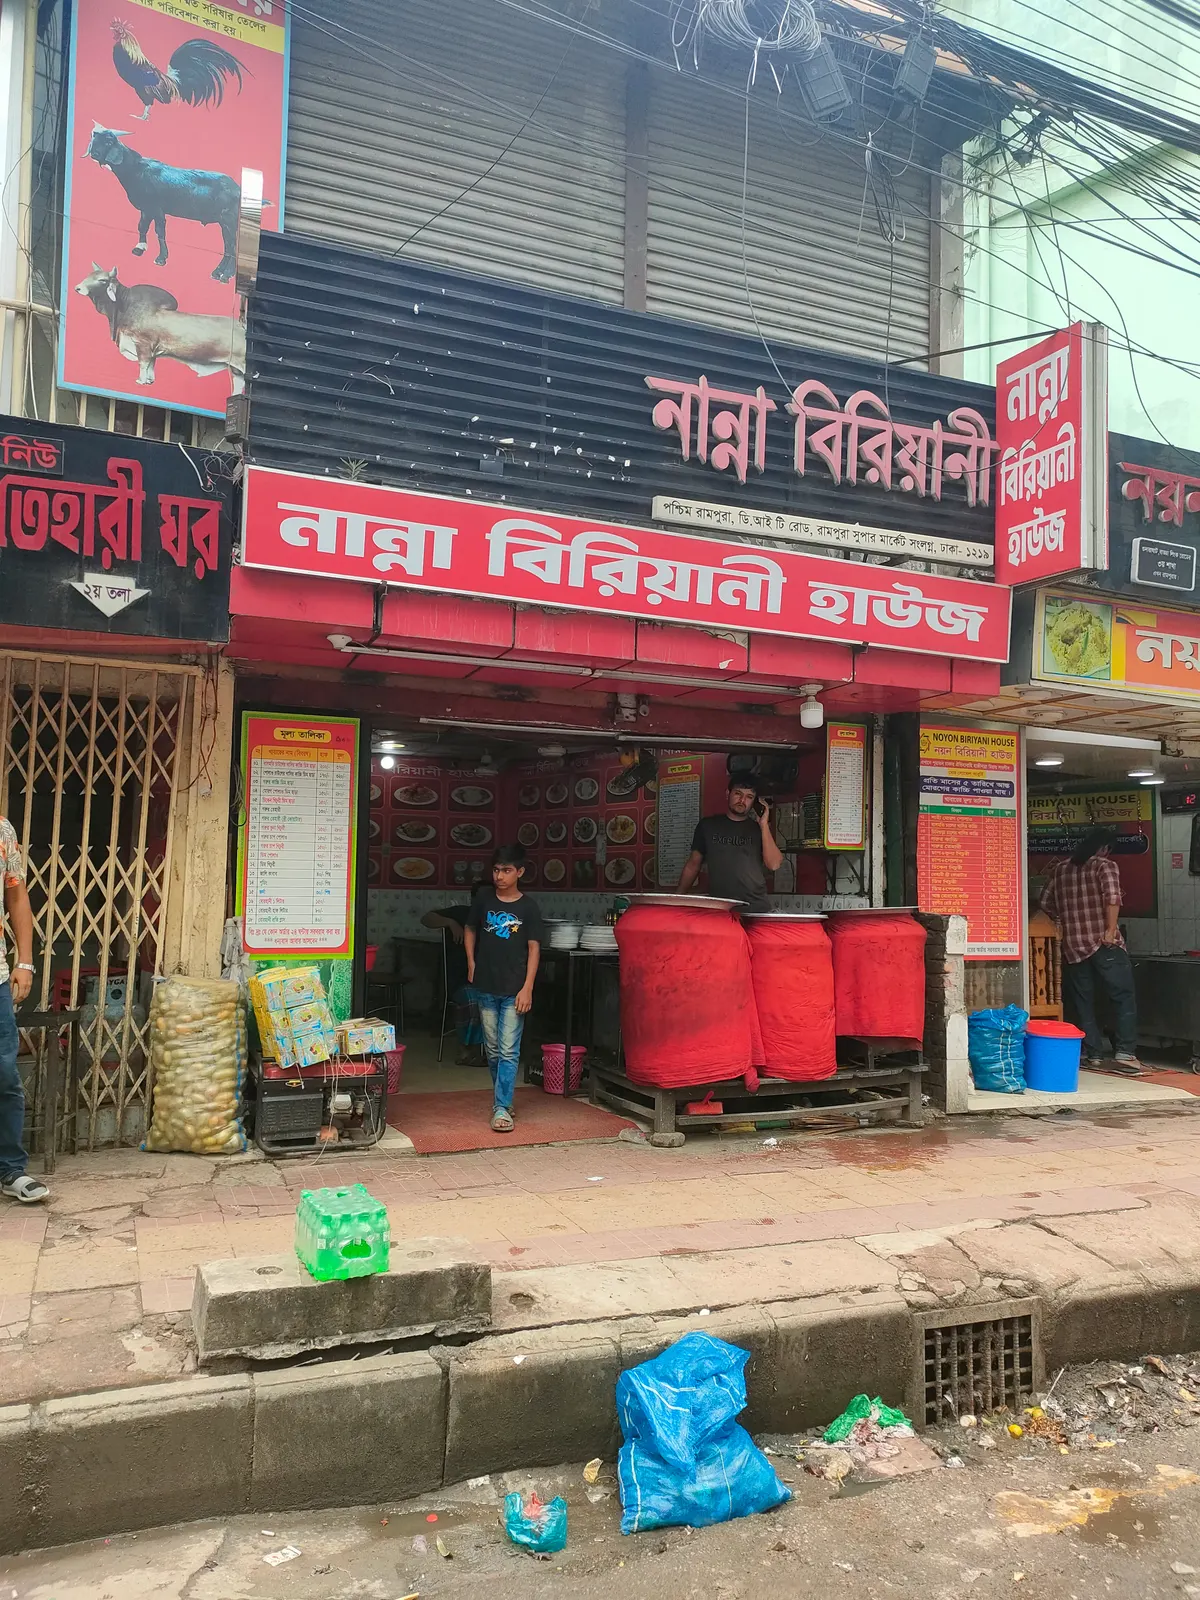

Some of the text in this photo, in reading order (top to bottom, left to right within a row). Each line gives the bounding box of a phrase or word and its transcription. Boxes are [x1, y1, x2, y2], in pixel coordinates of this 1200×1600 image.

[157, 1, 200, 23] পরিবেশন
[202, 15, 220, 31] করা
[202, 2, 235, 21] সরিষার
[237, 15, 267, 33] তেলের
[1006, 344, 1069, 423] নান্না
[0, 436, 61, 469] নিউ
[644, 375, 1000, 507] নান্না বিরিয়ানী
[1000, 422, 1076, 507] বিরিয়ানী
[158, 494, 222, 580] ঘর
[663, 501, 692, 517] পশ্চিম
[696, 507, 735, 526] রামপুরা,
[775, 515, 785, 530] টি
[789, 518, 813, 536] রোড,
[817, 524, 850, 541] রামপুরা
[852, 528, 876, 544] সুপার
[880, 532, 907, 547] মার্কেট
[910, 538, 937, 554] সংলগ্ন,
[966, 547, 990, 560] ১২১৯
[1007, 507, 1067, 568] হাউজ
[278, 500, 989, 642] নান্না বিরিয়ানী হাউজ
[83, 583, 132, 603] ২য় তলা
[1135, 629, 1200, 673] নয়
[280, 730, 295, 739] মূল্য
[298, 730, 325, 740] তালিকা
[933, 732, 1015, 747] NOYON BIRIYANI HOUSE
[934, 745, 1013, 761] নয়ন বিরিয়ানী হাউজ
[922, 776, 939, 784] প্রতি
[940, 778, 961, 786] মাসের
[970, 780, 994, 788] তারিখে
[922, 784, 950, 792] মোরগের
[952, 784, 971, 794] কাচ্চি
[1085, 794, 1136, 806] HOUSE
